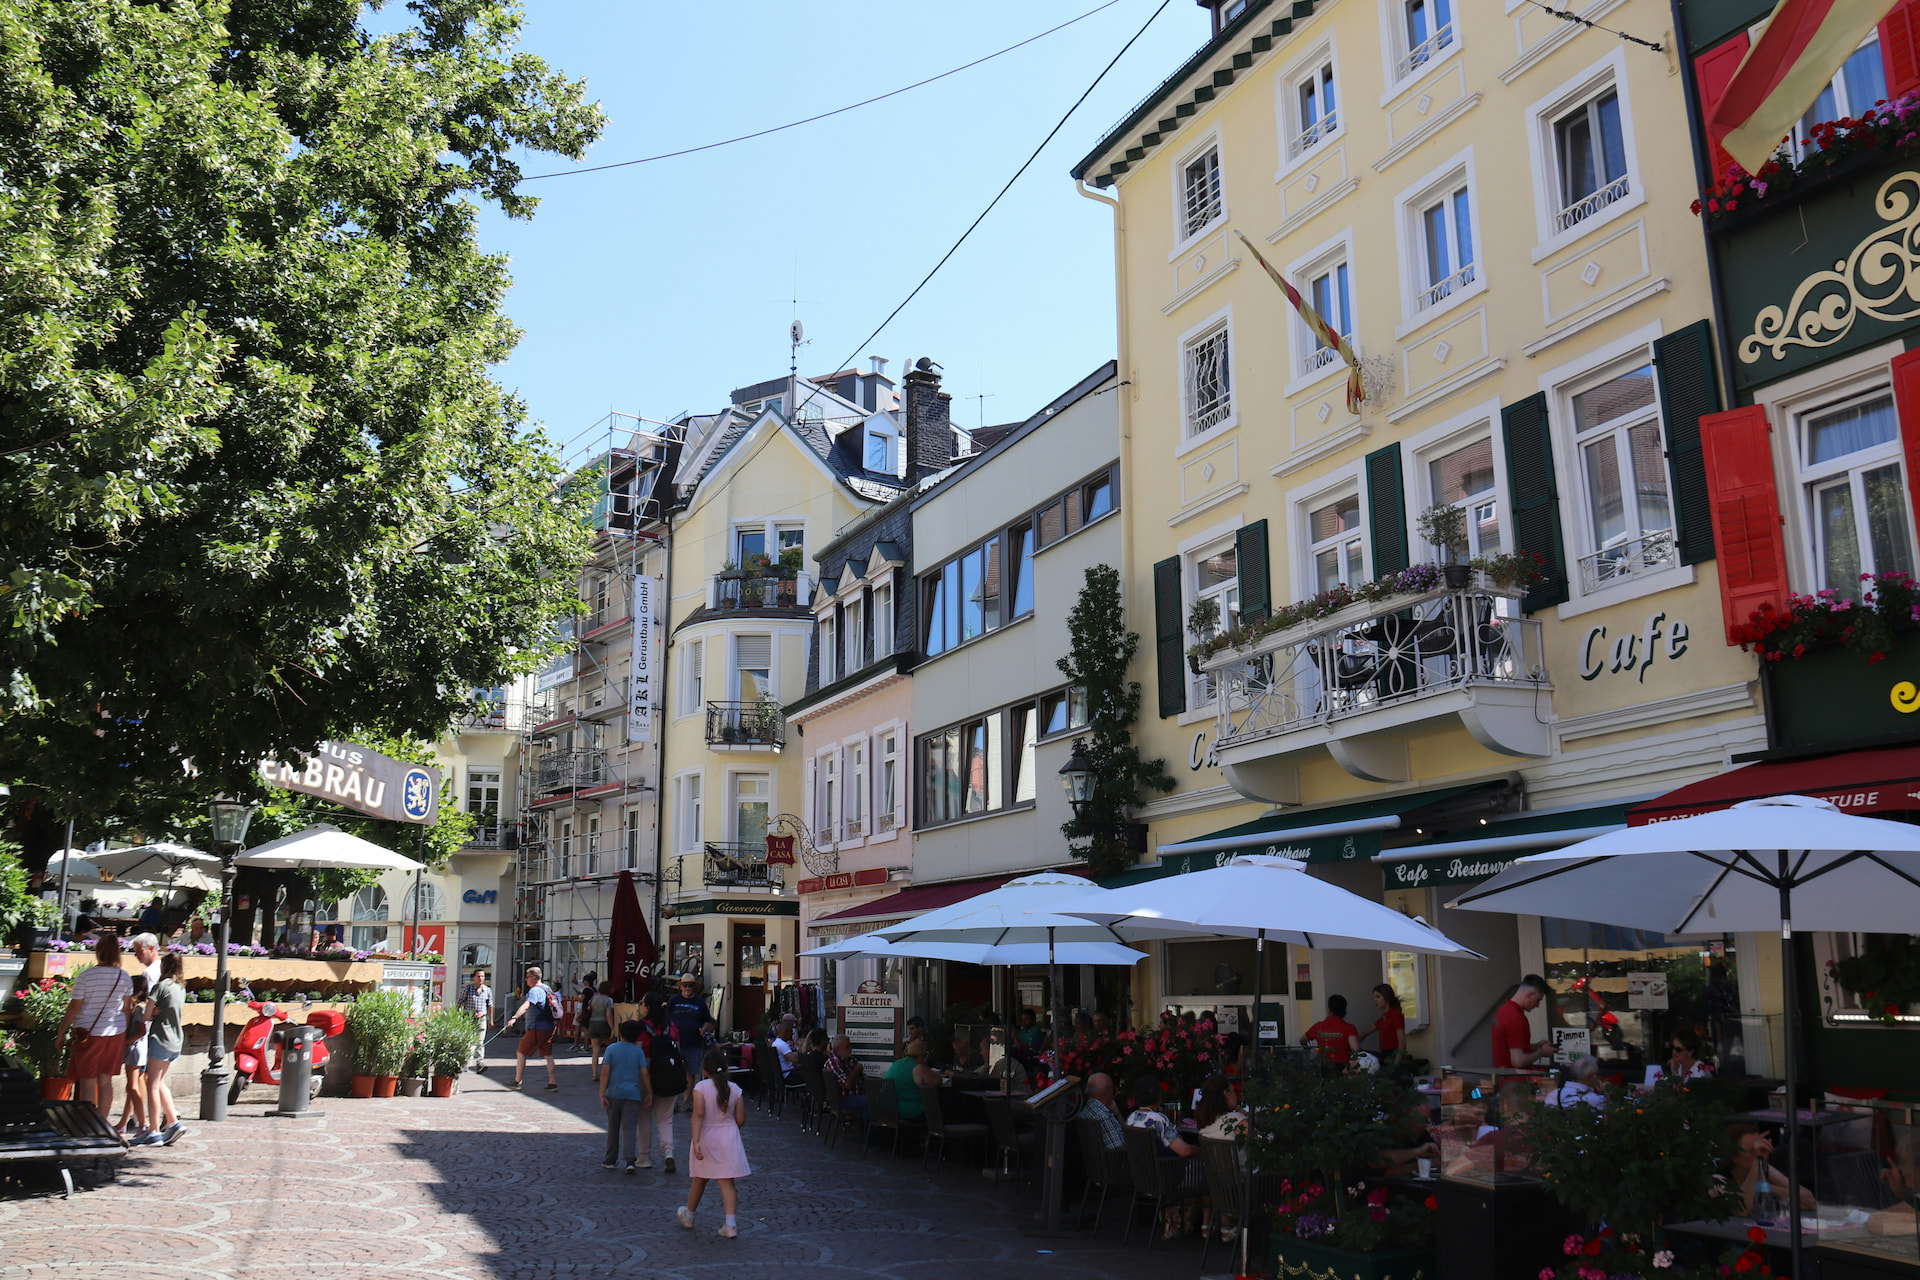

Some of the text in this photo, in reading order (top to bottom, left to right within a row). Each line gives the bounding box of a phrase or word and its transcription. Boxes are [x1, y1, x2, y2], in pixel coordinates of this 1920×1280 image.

[639, 582, 649, 614] GmbH
[638, 616, 649, 670] Gerüstbau
[1577, 611, 1689, 684] Cafe
[317, 740, 364, 766] aus
[1189, 731, 1219, 772] Ca
[261, 756, 387, 808] ENBRÄU
[1820, 791, 1880, 807] TUBE
[775, 841, 786, 849] LA
[1266, 844, 1312, 861] Rathaus
[769, 851, 791, 859] CASA
[1394, 863, 1429, 887] Cafe
[1446, 858, 1513, 878] Restaura
[829, 876, 849, 887] LA CASA
[715, 901, 775, 913] Casserole
[386, 970, 424, 978] SPEISEKARTE
[850, 994, 892, 1007] Laterne
